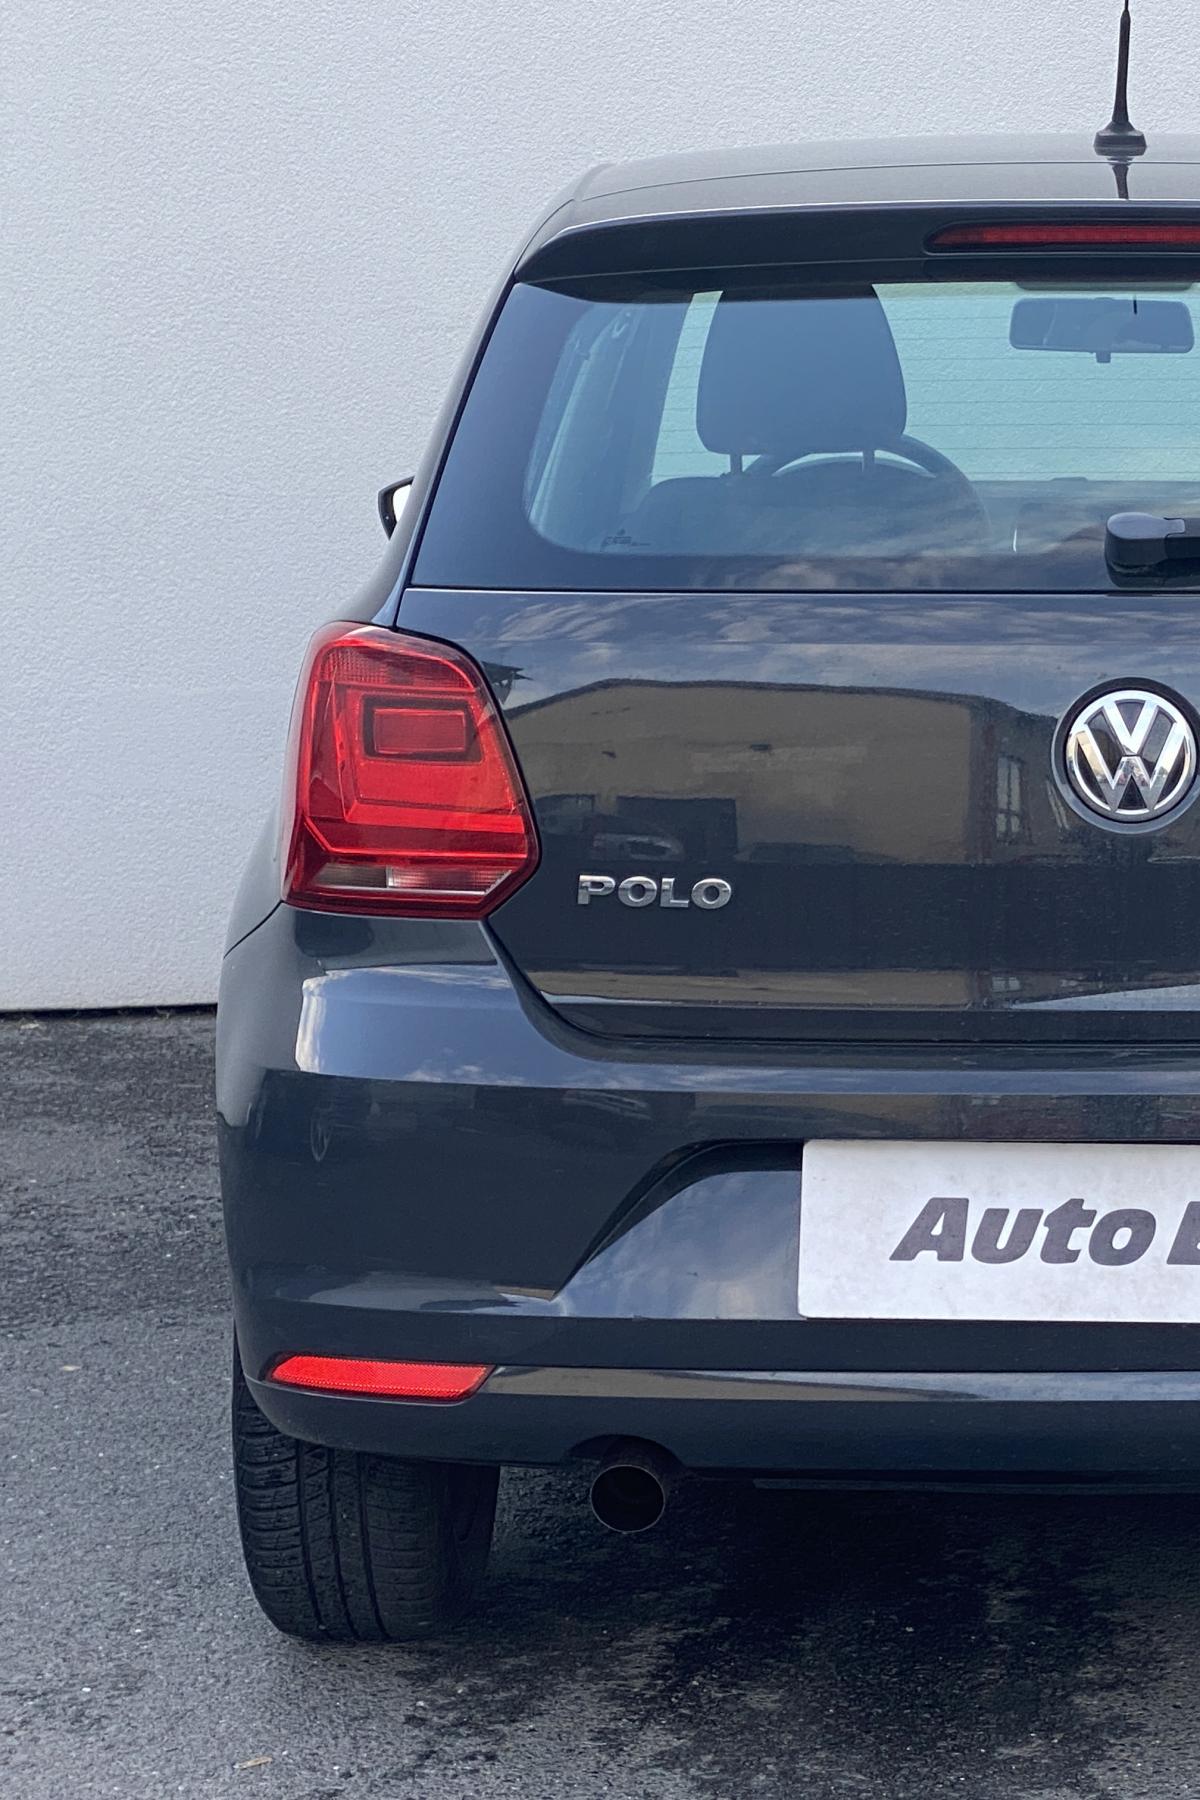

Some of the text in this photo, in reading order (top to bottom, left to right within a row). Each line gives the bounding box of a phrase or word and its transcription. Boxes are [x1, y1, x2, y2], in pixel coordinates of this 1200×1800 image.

[1066, 690, 1196, 822] VW
[577, 874, 732, 909] POLO
[889, 1196, 1158, 1267] Auto
